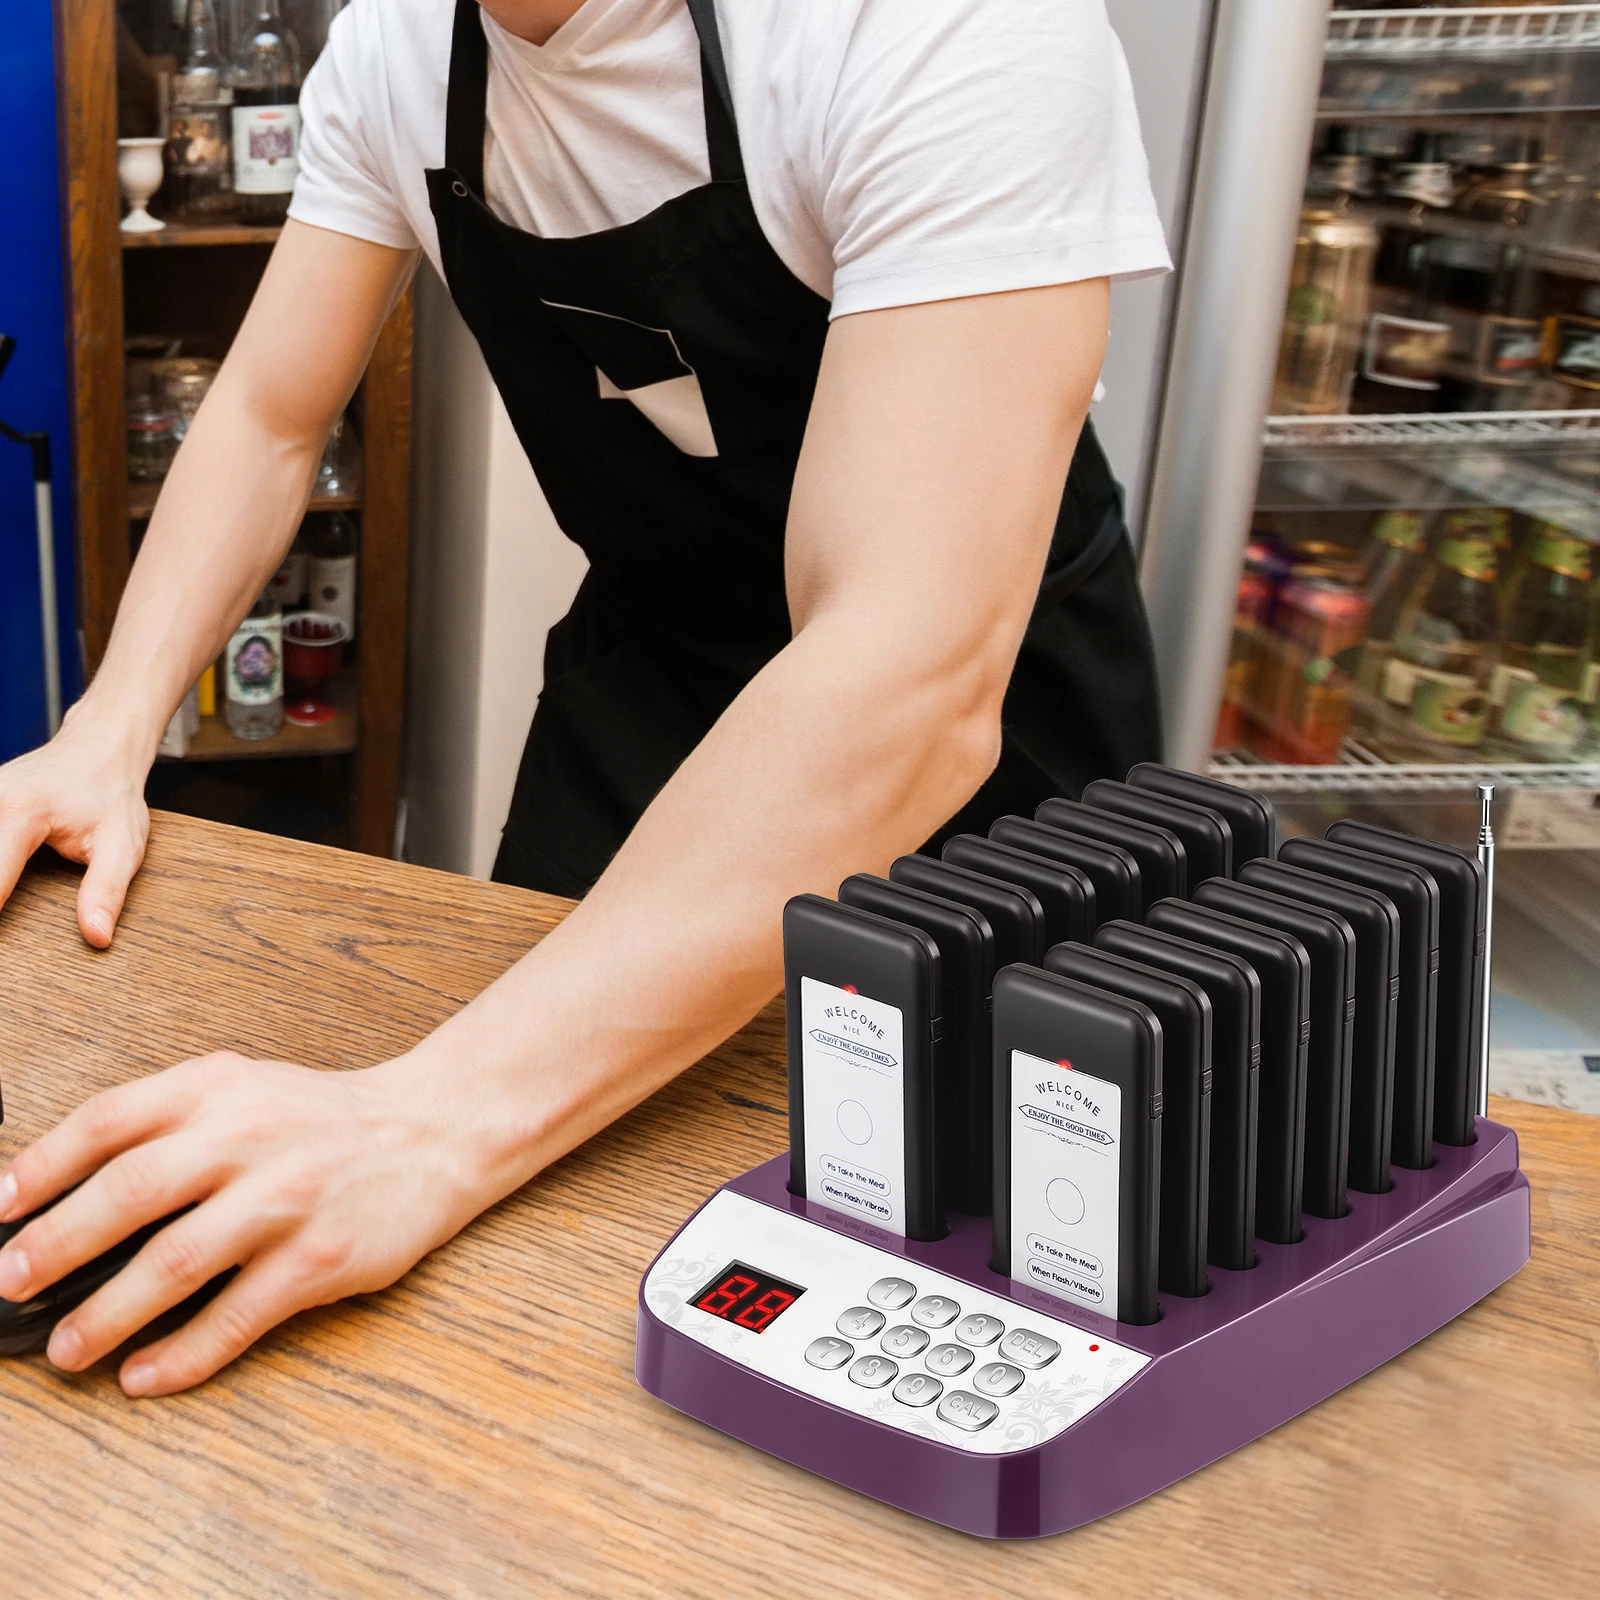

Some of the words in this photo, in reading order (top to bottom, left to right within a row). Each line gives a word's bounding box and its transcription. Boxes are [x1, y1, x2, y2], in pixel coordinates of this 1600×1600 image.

[824, 1006, 885, 1039] WELCOME
[843, 1024, 861, 1035] NICE
[818, 1033, 838, 1045] ENJOY
[838, 1041, 852, 1051] THE
[852, 1045, 870, 1057] GOOD
[870, 1051, 890, 1064] TIMES
[1035, 1081, 1101, 1117] WELCOME
[1055, 1100, 1075, 1112] NICE
[1028, 1108, 1050, 1121] ENJOY
[1050, 1116, 1065, 1128] THE
[1065, 1121, 1084, 1134] GOOD
[1085, 1128, 1106, 1142] TIMES
[827, 1162, 836, 1171] Pls
[837, 1165, 854, 1178] Take
[855, 1172, 867, 1183] The
[868, 1178, 885, 1190] Meal
[825, 1184, 843, 1197] When
[843, 1191, 889, 1215] Flash/Vibrate
[1034, 1241, 1044, 1252] Pls
[1045, 1245, 1064, 1259] Take
[1064, 1252, 1078, 1264] The
[1078, 1258, 1098, 1272] Meal
[1031, 1264, 1051, 1278] When
[1051, 1272, 1101, 1298] Flash/Vibrate
[882, 1283, 899, 1300] 1
[921, 1298, 944, 1319] 2
[967, 1317, 988, 1335] 3
[1009, 1332, 1045, 1359] DEL
[851, 1312, 872, 1330] 4
[893, 1328, 915, 1347] 5
[938, 1347, 958, 1365] 6
[986, 1366, 1008, 1385] 0
[819, 1340, 842, 1359] 7
[861, 1359, 882, 1377] 8
[906, 1377, 926, 1395] 9
